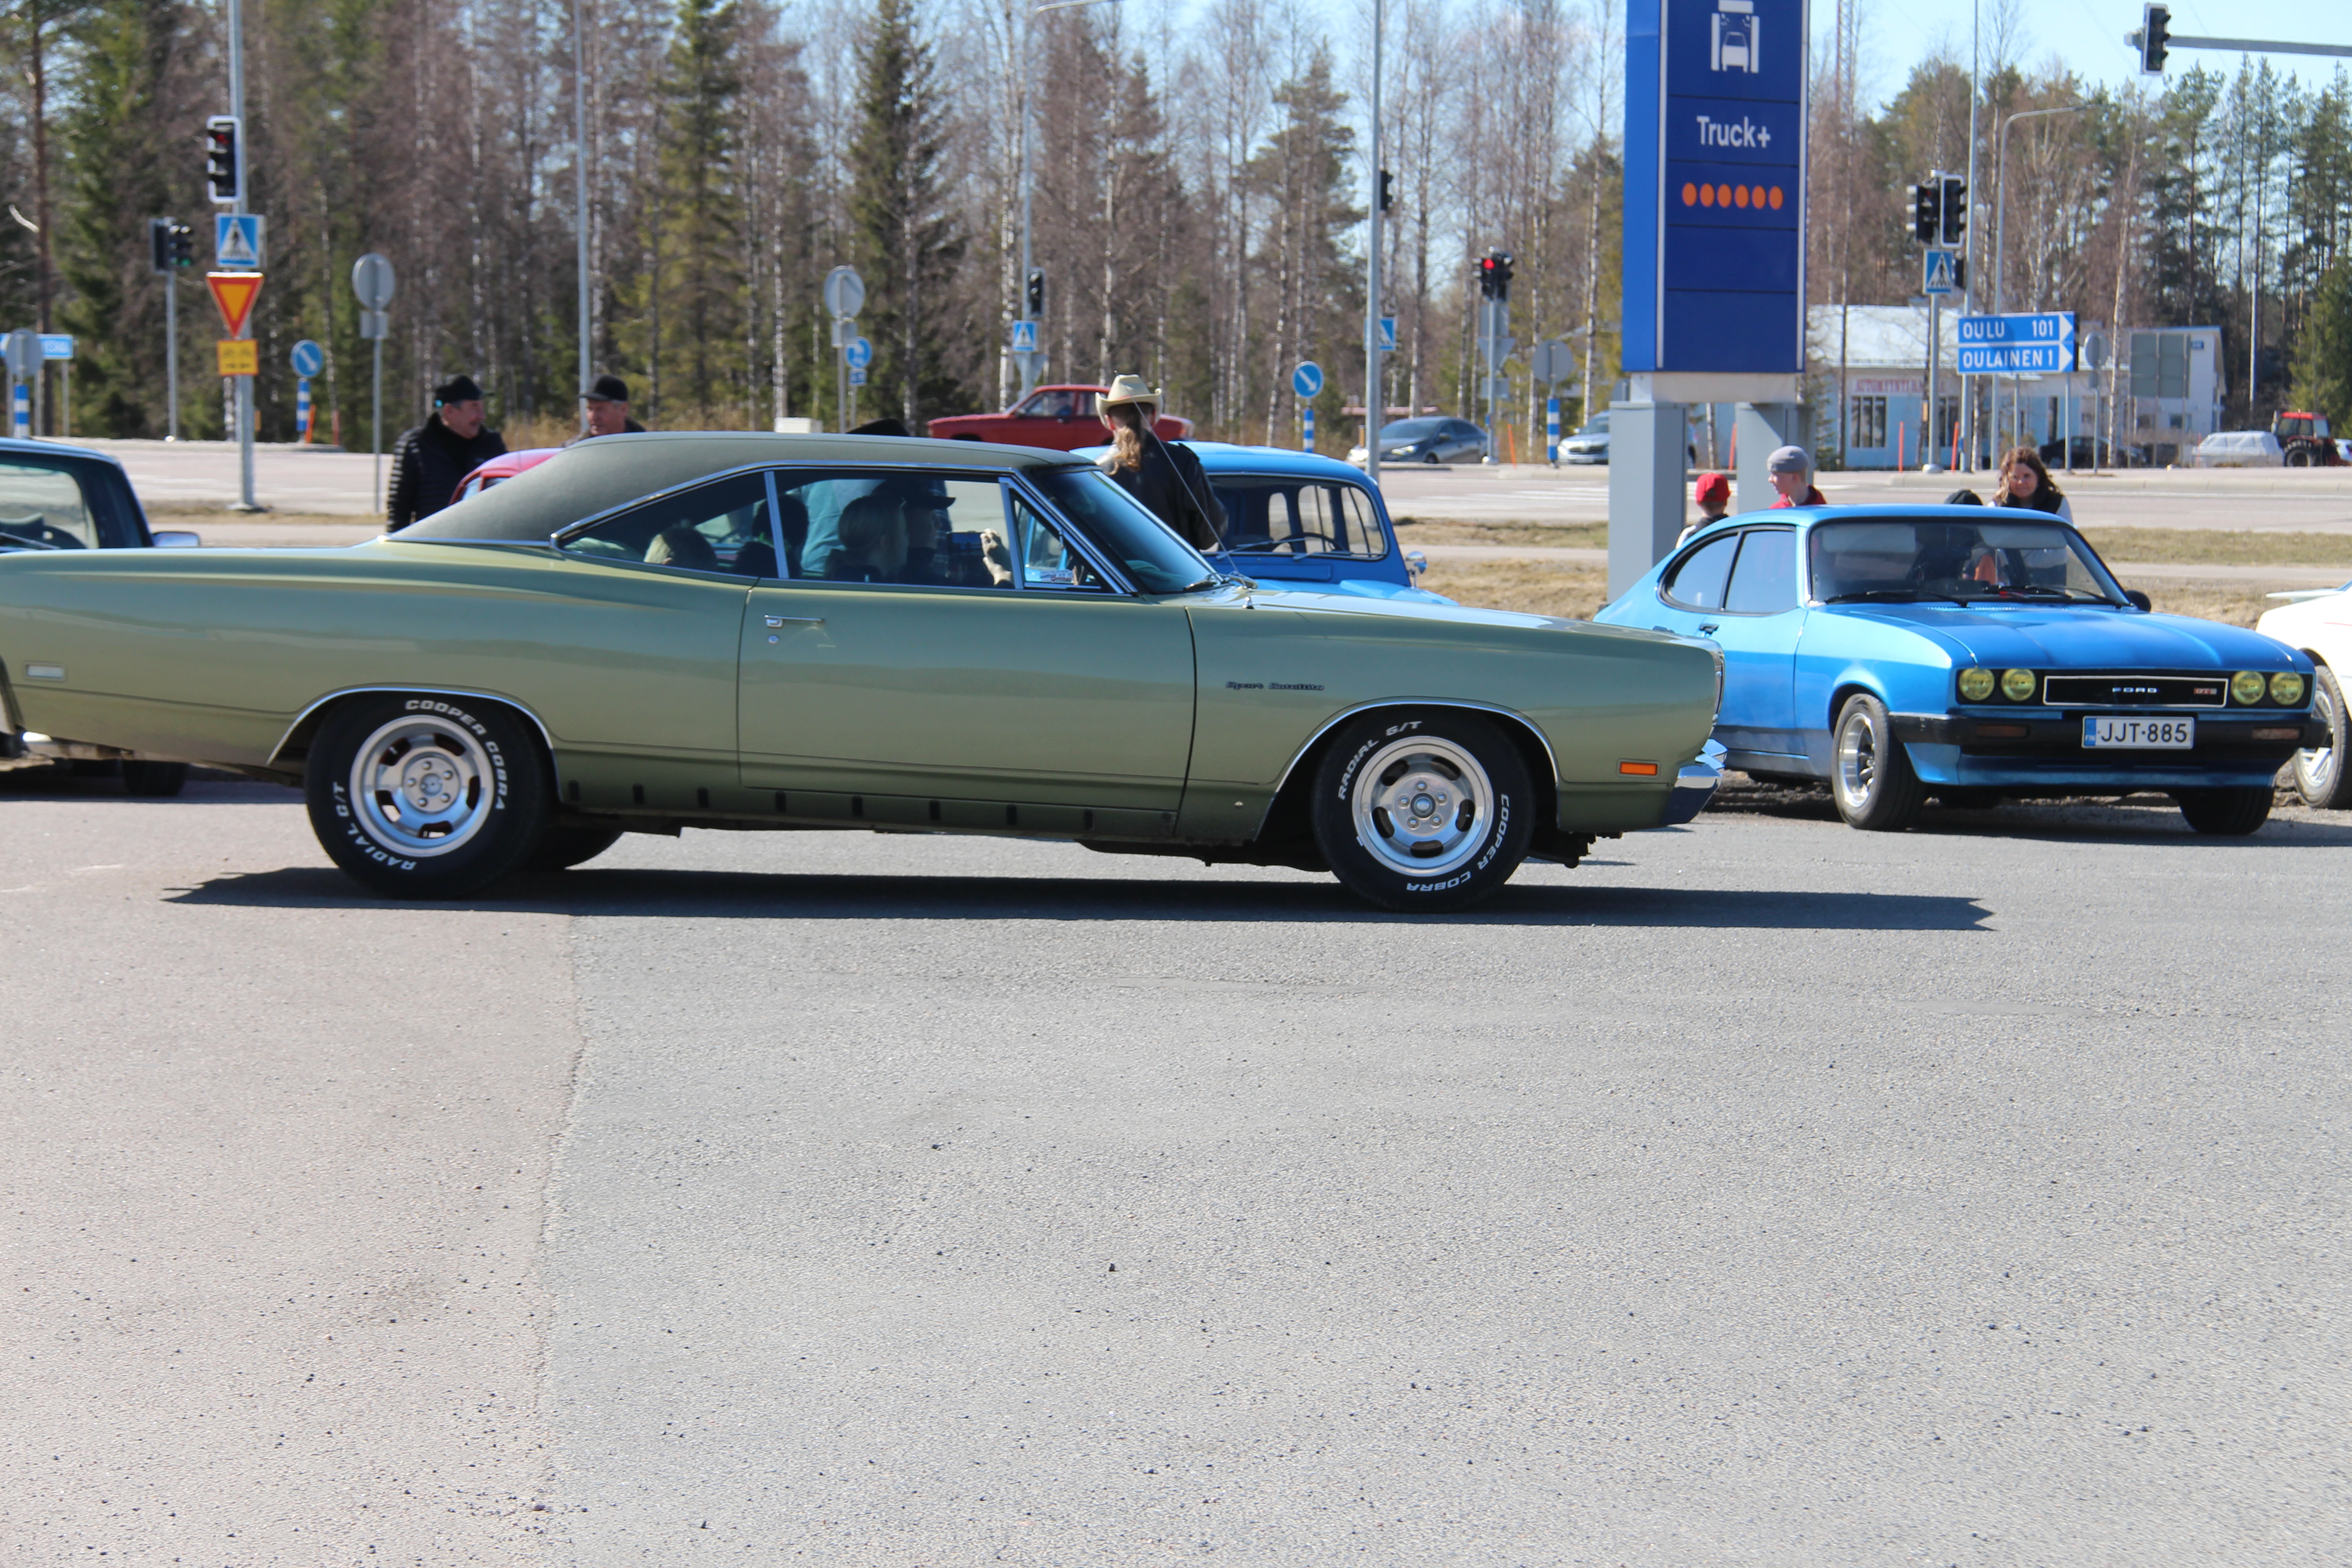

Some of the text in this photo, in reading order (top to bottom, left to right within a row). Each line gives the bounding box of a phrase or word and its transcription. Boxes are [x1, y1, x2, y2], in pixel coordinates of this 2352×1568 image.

[1696, 115, 1771, 148] Truck+
[1963, 319, 2053, 339] OULU 101
[1963, 348, 2053, 368] OULAINEN 1
[405, 700, 508, 809] COOPER COBRA
[1338, 721, 1423, 800] RADIAL G/T
[2101, 723, 2187, 742] JJT-885
[333, 781, 417, 870] RADIAL G/T
[1406, 794, 1509, 892] COOPER COBRA
